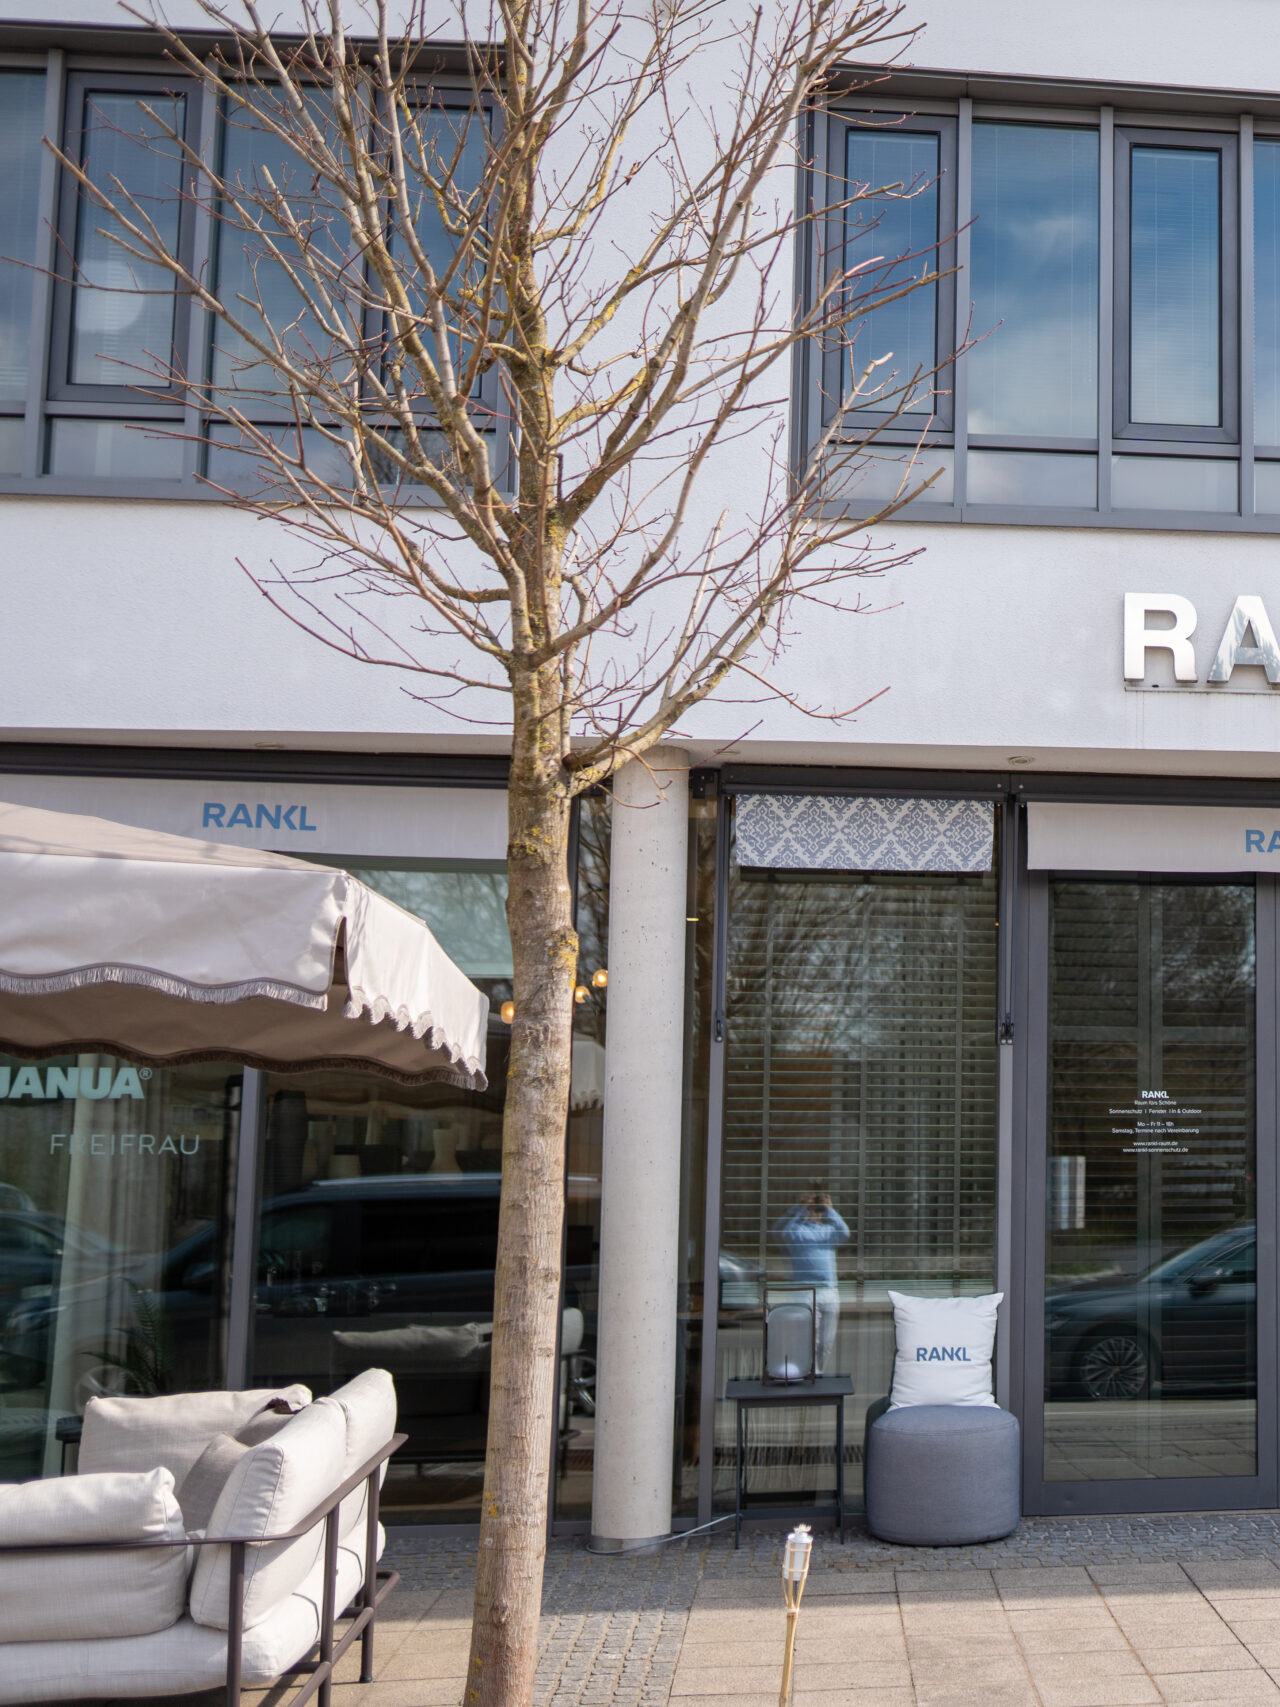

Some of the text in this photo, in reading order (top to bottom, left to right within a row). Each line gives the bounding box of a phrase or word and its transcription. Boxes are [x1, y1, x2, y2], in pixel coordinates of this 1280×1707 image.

[202, 802, 317, 832] RANKL
[1141, 1091, 1169, 1099] RANKL
[50, 1134, 200, 1155] FREIFRAU
[916, 1346, 971, 1362] RANKL
